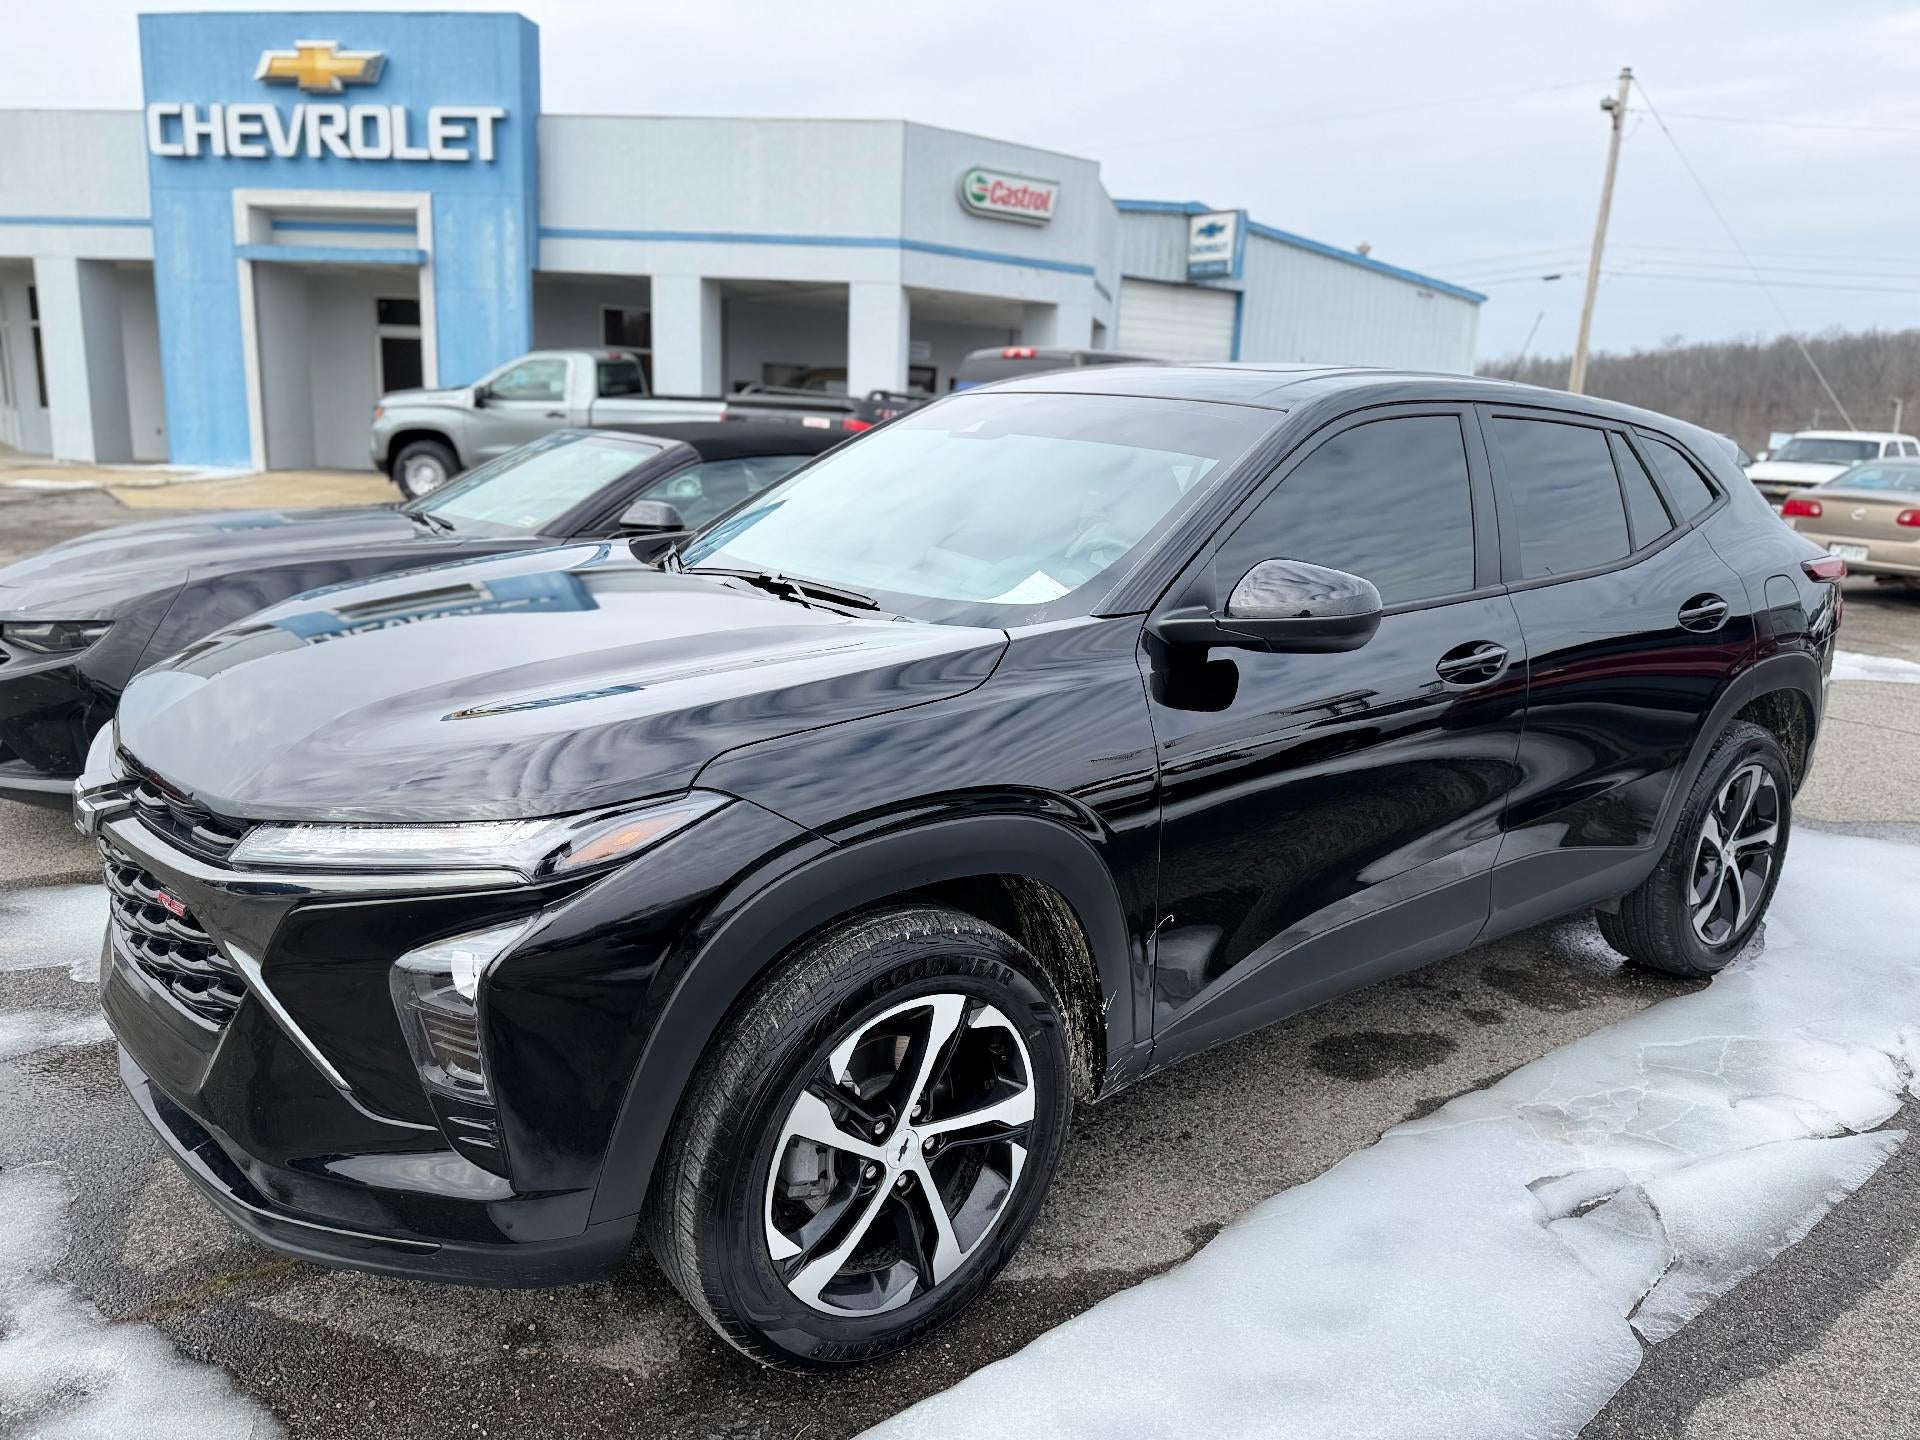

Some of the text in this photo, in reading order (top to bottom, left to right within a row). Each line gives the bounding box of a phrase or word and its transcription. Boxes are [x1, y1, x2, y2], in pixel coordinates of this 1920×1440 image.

[147, 103, 505, 161] CHEVROLET
[990, 180, 1050, 212] Castrol
[157, 891, 186, 918] RS
